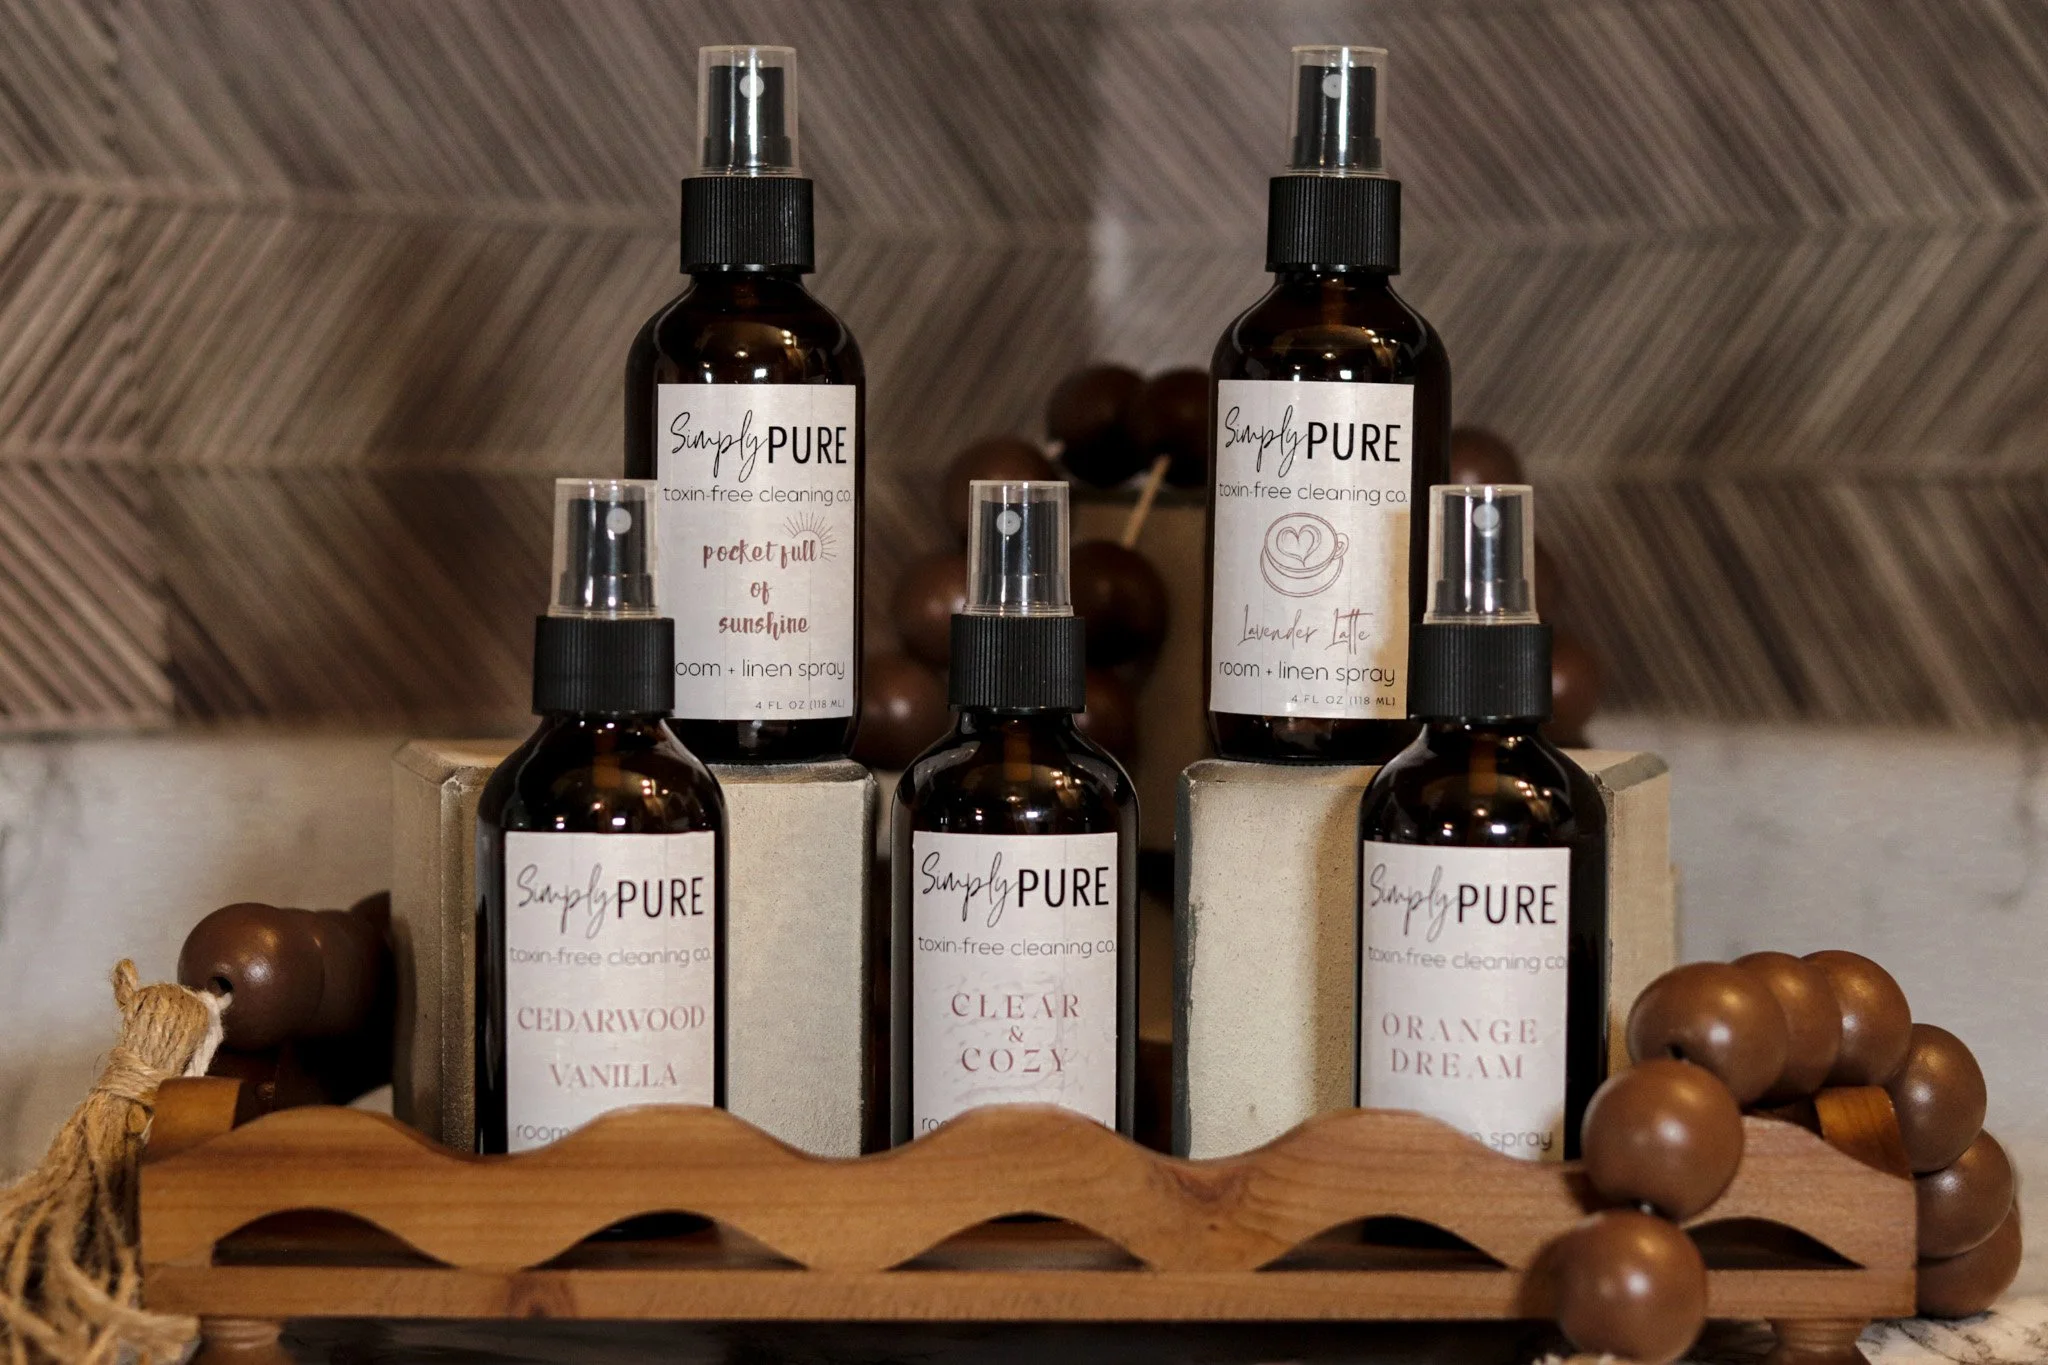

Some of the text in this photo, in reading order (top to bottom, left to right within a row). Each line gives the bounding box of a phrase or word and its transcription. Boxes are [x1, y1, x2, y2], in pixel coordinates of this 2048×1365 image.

[663, 485, 753, 502] toxin-free
[759, 486, 833, 506] cleaning
[1219, 481, 1408, 506] toxin-free cleaning co.
[703, 539, 818, 569] pocket full
[750, 581, 773, 605] of
[718, 611, 810, 641] sunshine
[1237, 604, 1373, 655] Lavender Latte
[675, 658, 845, 681] oom + linen spray
[1219, 660, 1395, 687] room + linen spray
[755, 701, 762, 709] 4
[768, 701, 783, 709] FL
[789, 701, 805, 710] OZ
[1291, 694, 1396, 706] 4 FL OZ (118 ML)
[509, 947, 601, 966] toxin-free
[606, 948, 690, 968] cleaning
[918, 937, 1005, 955] toxin-free
[1010, 939, 1092, 959] cleaning
[1451, 951, 1541, 974] cleaning
[951, 993, 1080, 1018] CLEAR
[517, 1005, 705, 1033] CEDARWOOD
[1381, 1012, 1538, 1044] ORANGE
[1008, 1025, 1024, 1043] &
[961, 1047, 1067, 1073] COZY
[1391, 1048, 1523, 1079] DREAM
[550, 1063, 678, 1088] VANILLA
[1490, 1131, 1552, 1151] spray
